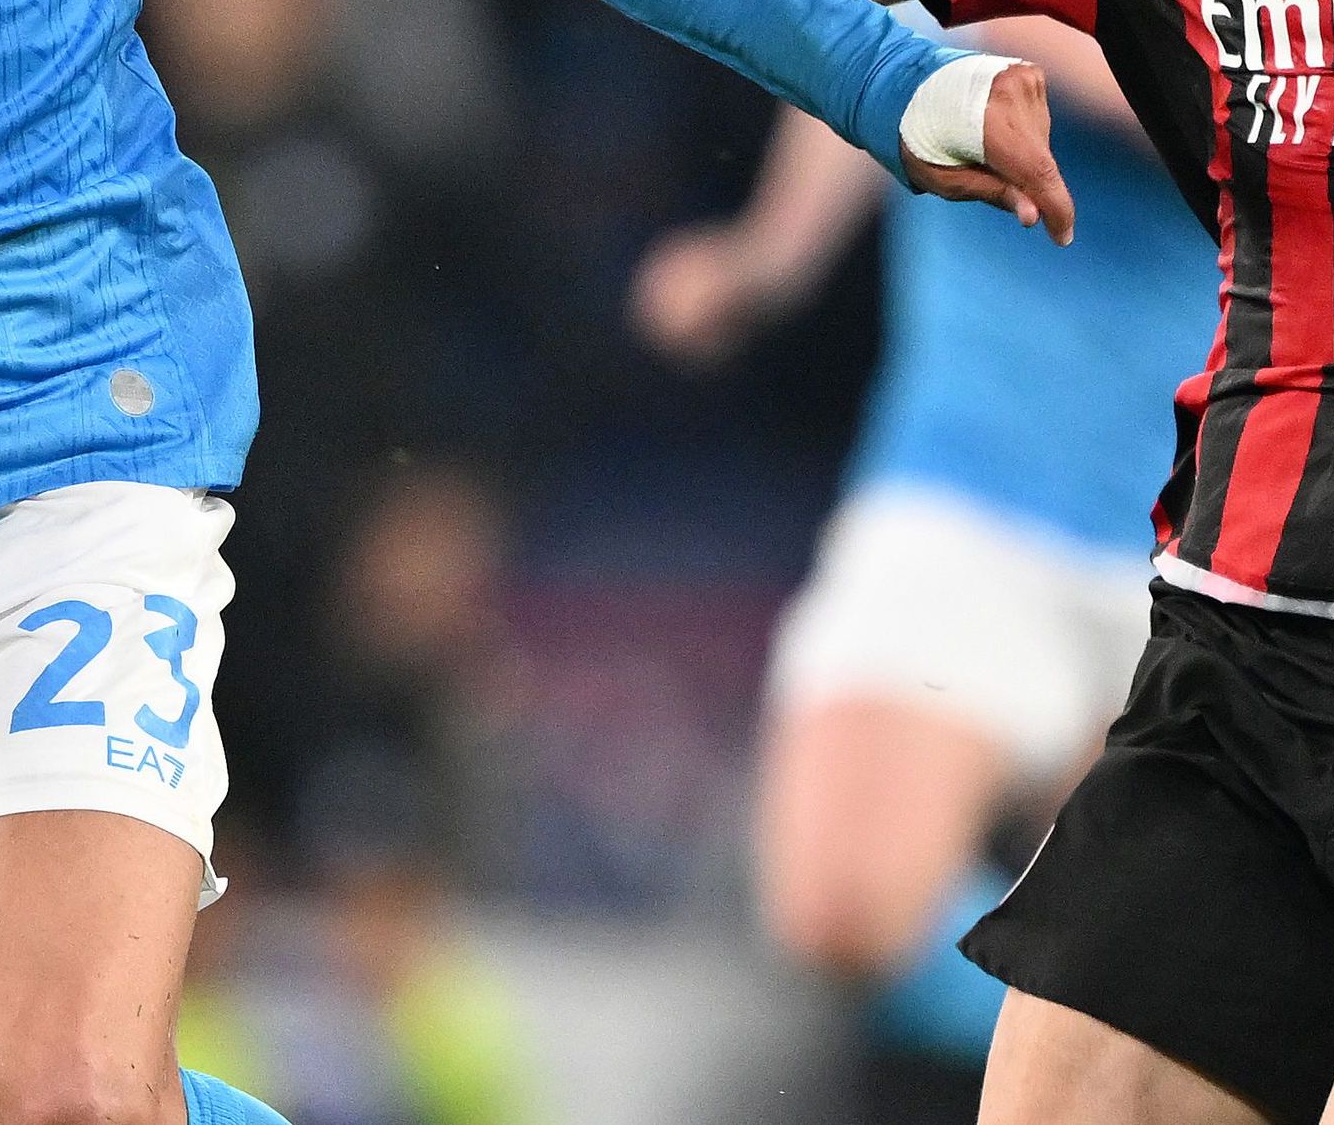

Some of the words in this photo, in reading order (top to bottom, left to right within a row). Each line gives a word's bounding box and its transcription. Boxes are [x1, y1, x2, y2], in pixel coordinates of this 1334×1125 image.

[1246, 74, 1320, 145] FLY
[8, 593, 200, 750] 23
[107, 735, 186, 790] EA7
